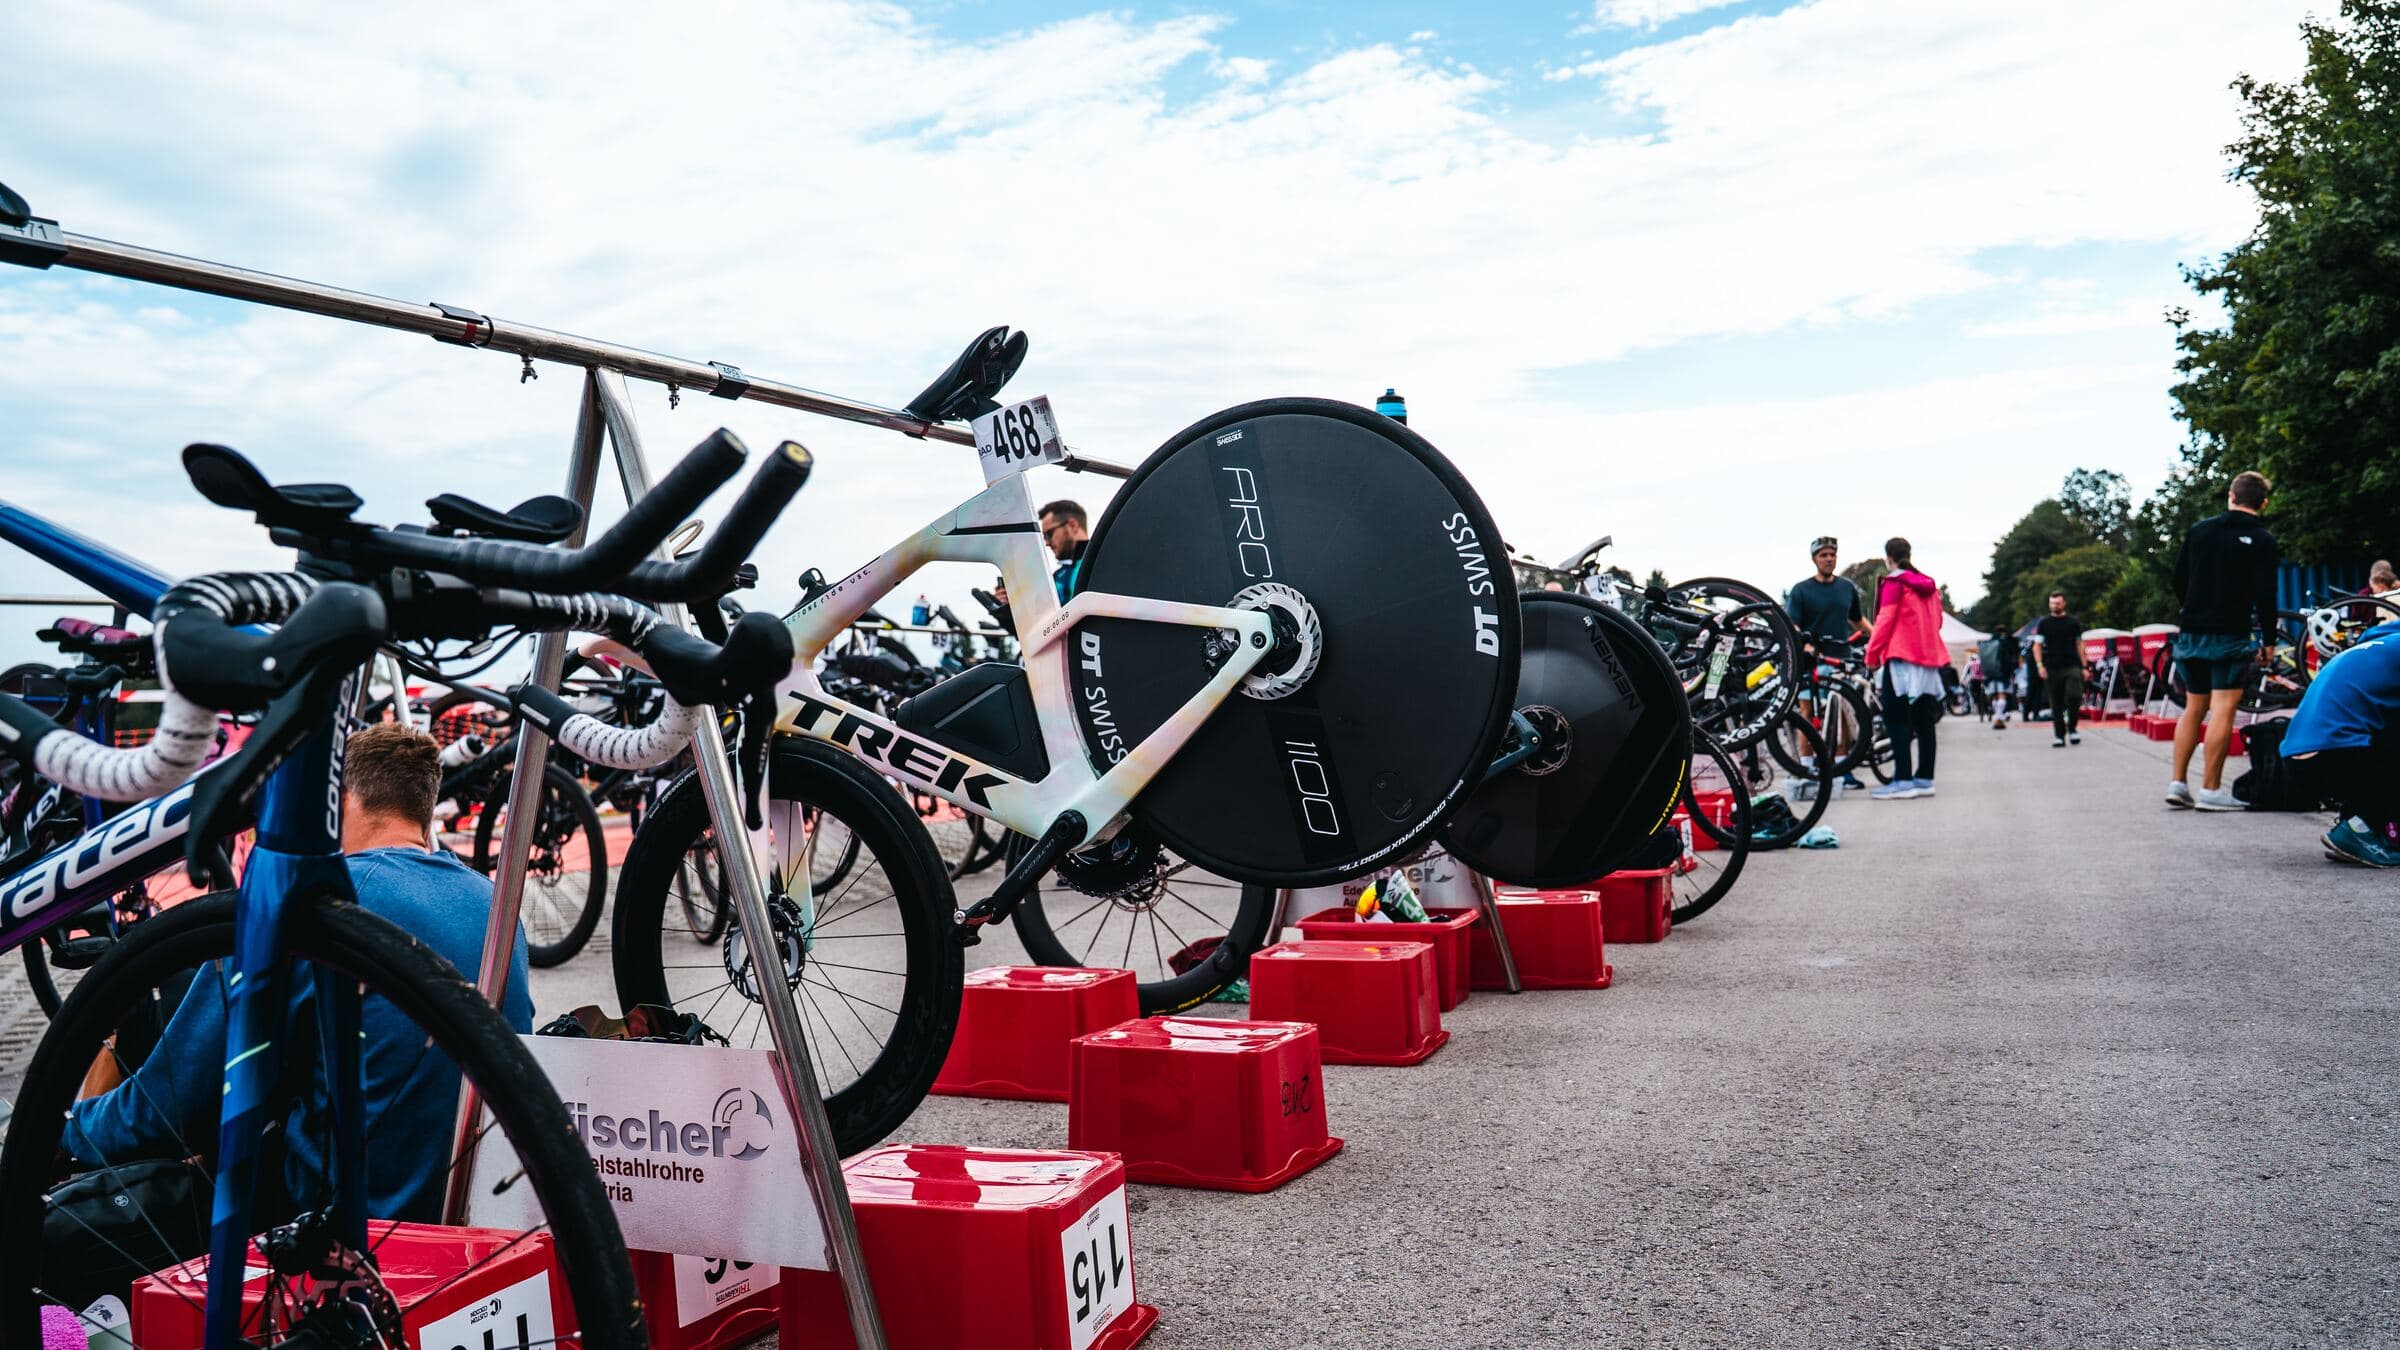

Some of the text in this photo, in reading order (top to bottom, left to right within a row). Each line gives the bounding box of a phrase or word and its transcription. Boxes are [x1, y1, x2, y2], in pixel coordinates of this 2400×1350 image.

[993, 404, 1042, 464] 468
[1222, 467, 1273, 578] ARC
[1441, 512, 1500, 657] DT SWISS
[1080, 631, 1129, 765] DT SWISS
[326, 671, 355, 840] corrate
[788, 690, 1011, 811] TREK
[1285, 741, 1340, 836] 1100
[1360, 845, 1392, 866] 5000
[1391, 828, 1416, 851] PRIX
[1415, 799, 1447, 834] GRAND
[591, 1154, 705, 1184] elstahlrohre
[1072, 1223, 1124, 1324] 115
